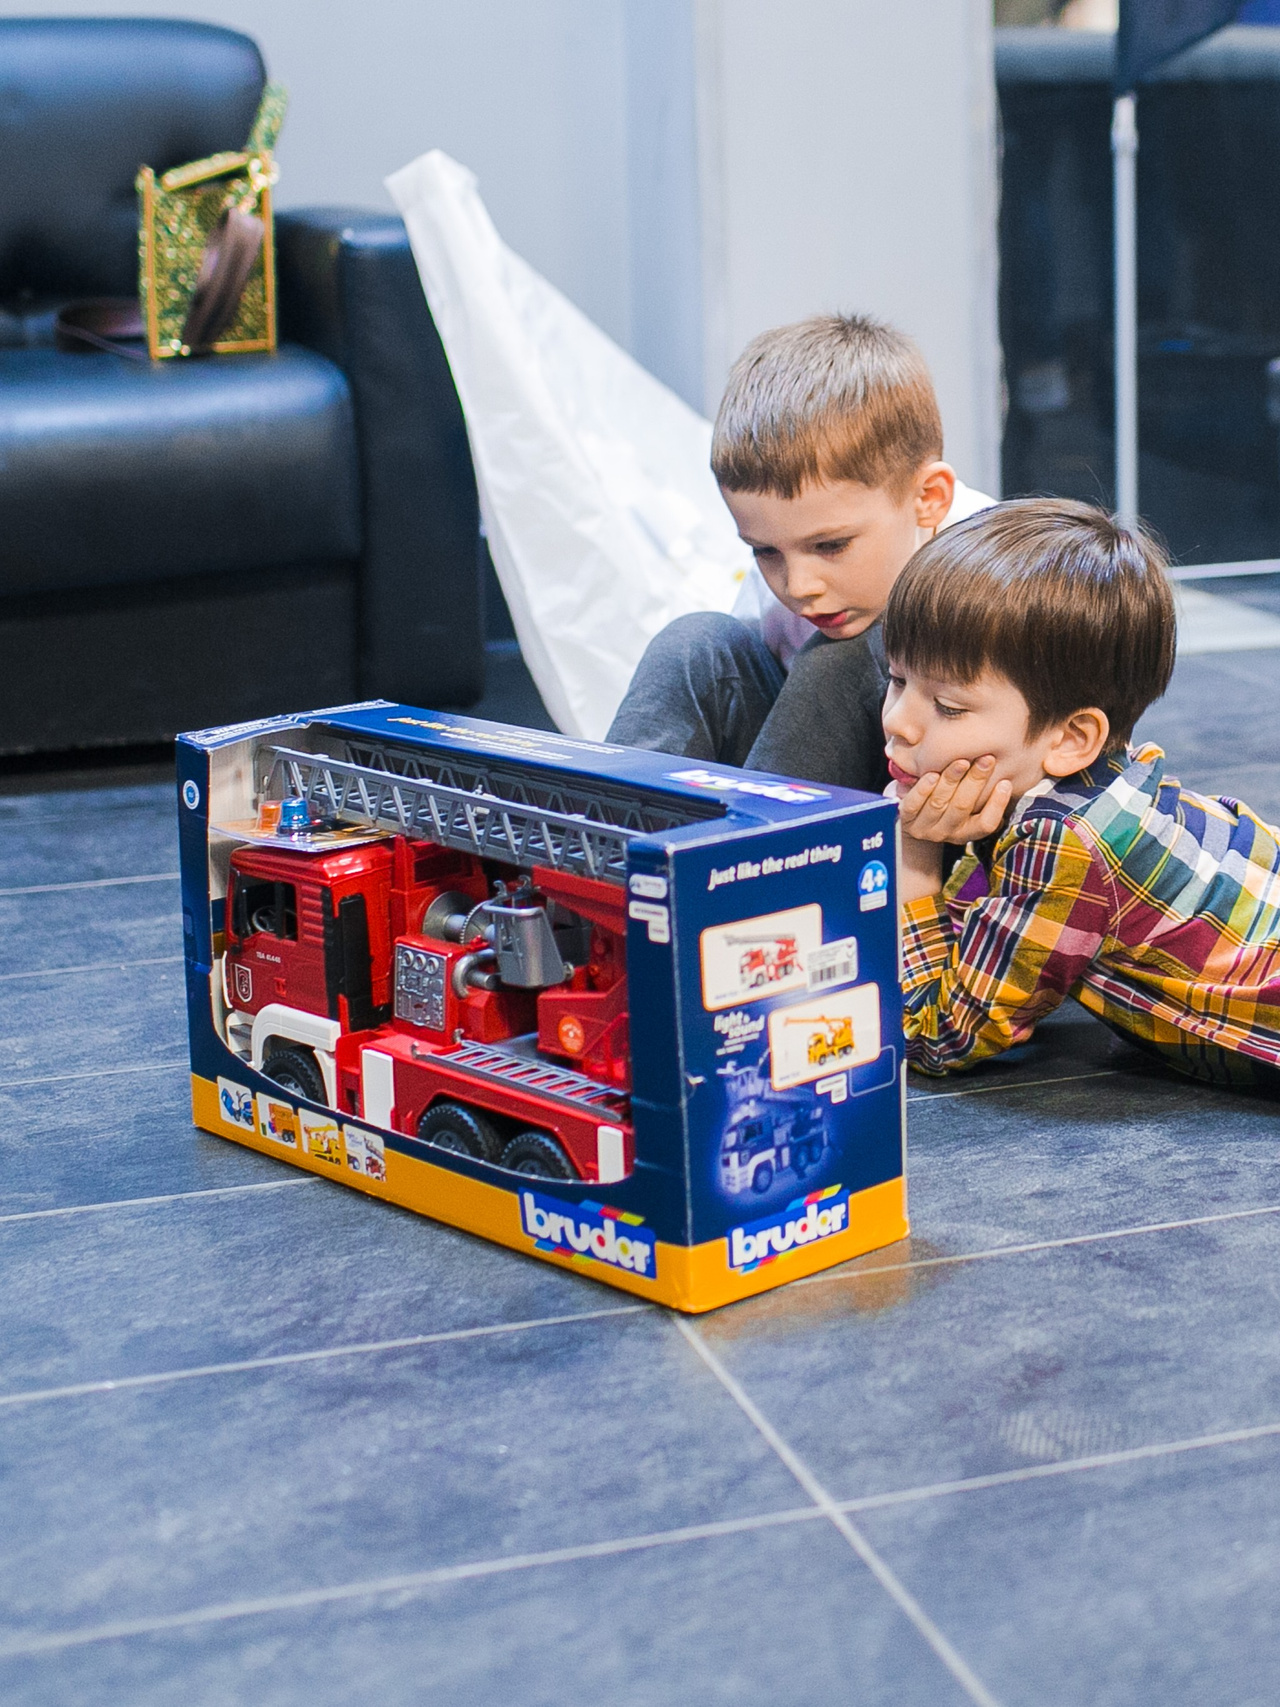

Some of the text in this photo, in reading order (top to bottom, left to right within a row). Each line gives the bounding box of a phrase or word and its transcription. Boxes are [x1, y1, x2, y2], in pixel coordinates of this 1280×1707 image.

[707, 844, 842, 891] just like the real thing
[861, 868, 886, 892] 4+
[713, 1010, 744, 1034] light
[728, 1014, 765, 1039] sound
[523, 1191, 651, 1274] bruder
[731, 1202, 847, 1267] bruder
